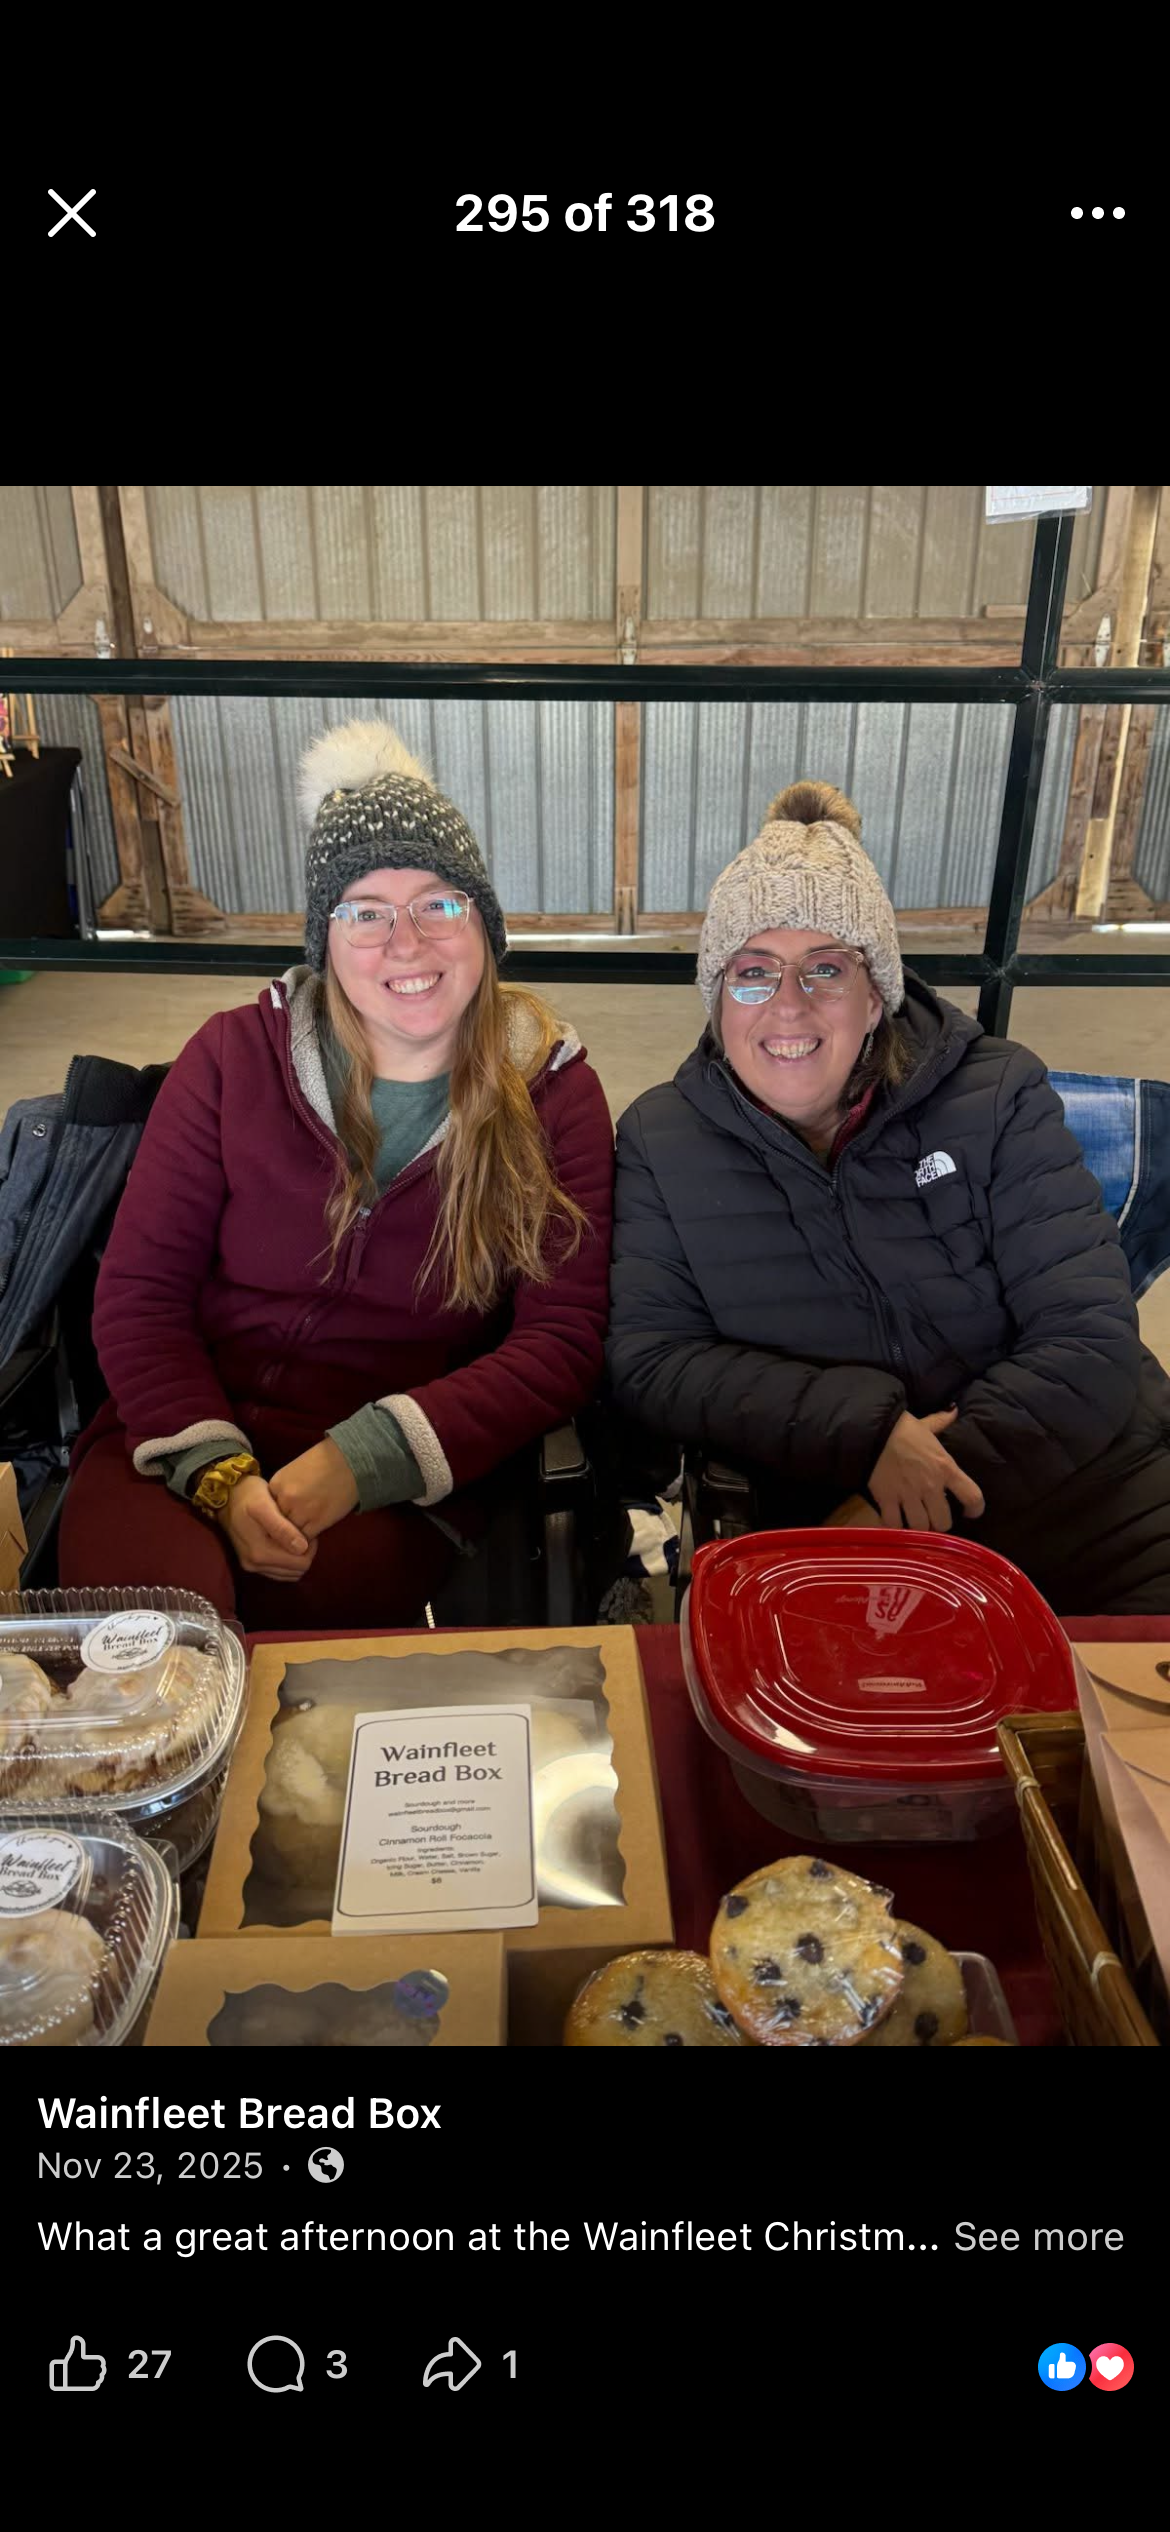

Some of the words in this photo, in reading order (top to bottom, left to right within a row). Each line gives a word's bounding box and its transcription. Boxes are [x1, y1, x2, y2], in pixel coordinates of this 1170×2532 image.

[919, 1155, 934, 1168] THE
[914, 1161, 936, 1179] ORTH
[915, 1171, 937, 1187] FACE
[102, 1626, 163, 1645] Wainfleet
[103, 1641, 136, 1651] Bread
[139, 1637, 159, 1646] Box
[380, 1741, 498, 1762] Wainfleet
[374, 1766, 446, 1787] Bread
[455, 1764, 503, 1782] Box
[410, 1823, 462, 1833] Sourdough
[378, 1836, 427, 1847] Cinnamon
[429, 1834, 447, 1842] Roll
[449, 1832, 493, 1841] Focaccia
[1, 1853, 75, 1872] Wainfleet
[0, 1867, 35, 1879] Bread
[38, 1870, 61, 1881] Box
